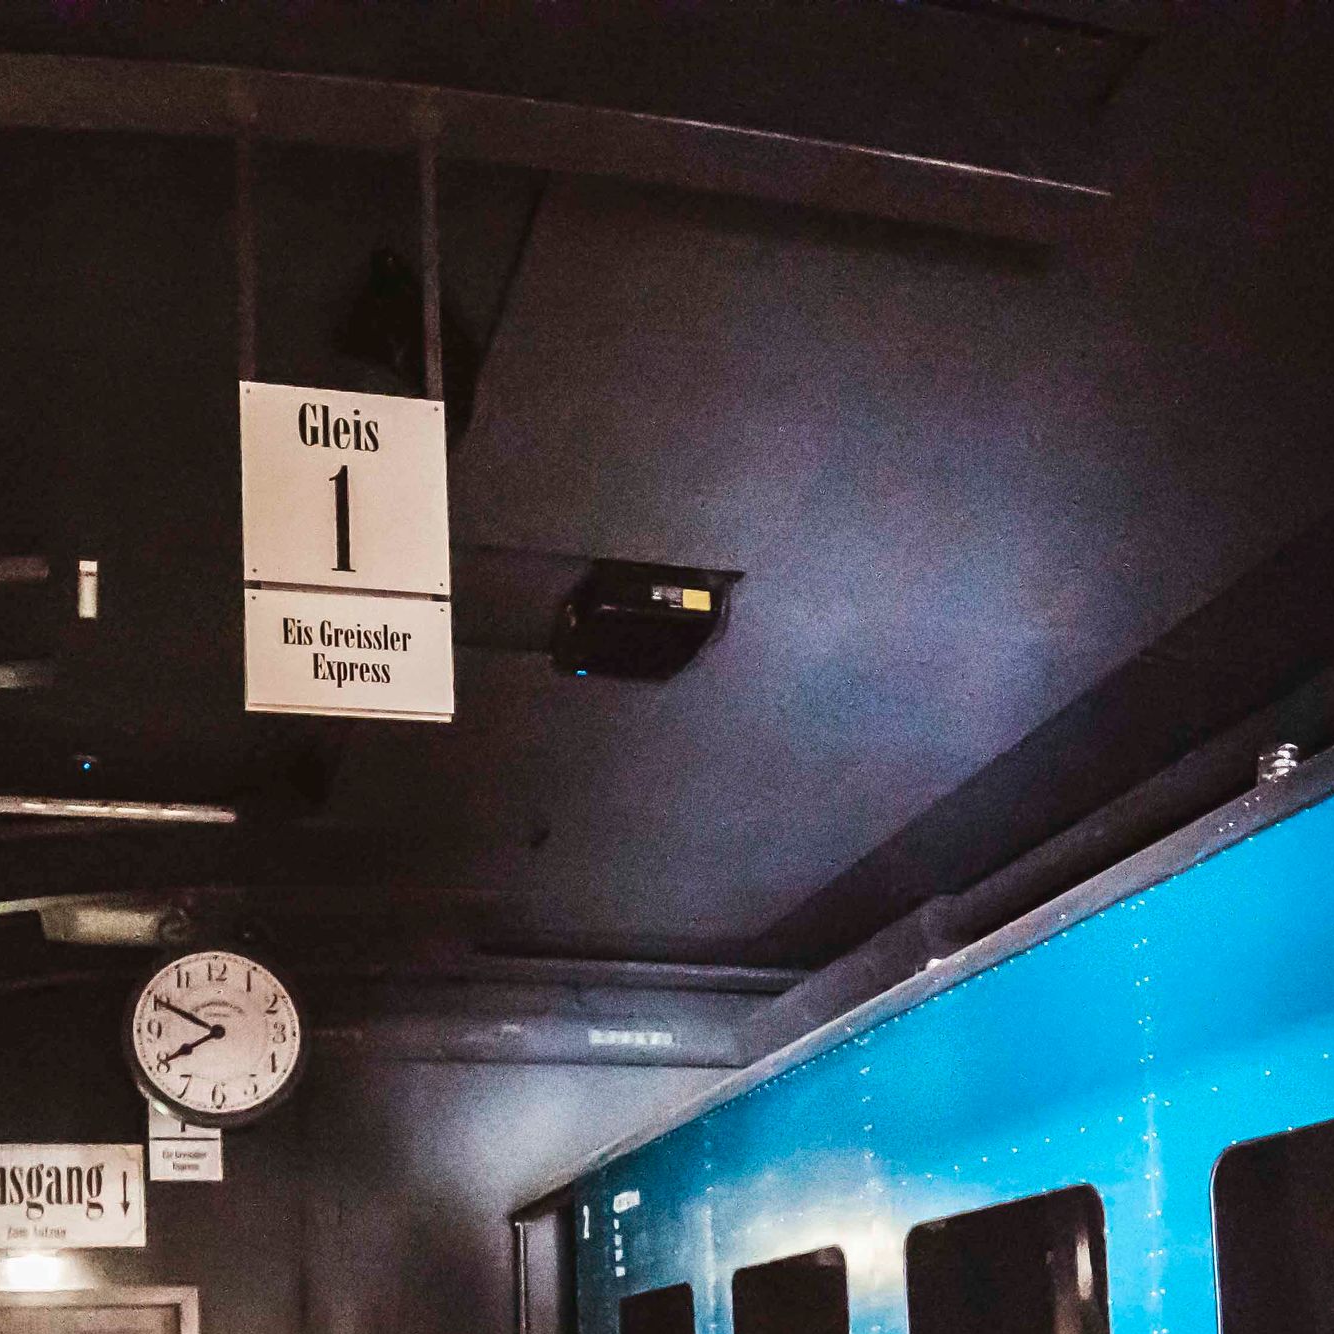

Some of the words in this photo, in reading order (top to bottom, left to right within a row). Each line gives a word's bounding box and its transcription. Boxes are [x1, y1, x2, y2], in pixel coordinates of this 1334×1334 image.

[298, 402, 379, 452] Gleis
[329, 465, 356, 572] 1
[282, 617, 313, 646] Eis
[320, 619, 412, 652] Greissler
[312, 652, 391, 688] Express
[177, 969, 190, 988] 11
[208, 962, 227, 982] 12
[246, 970, 252, 992] 1
[265, 993, 278, 1014] 2
[147, 1019, 163, 1043] 9
[273, 1022, 286, 1044] 3
[157, 1051, 171, 1073] 8
[178, 1074, 192, 1099] 7
[212, 1082, 226, 1109] 6
[583, 1205, 590, 1239] 1
